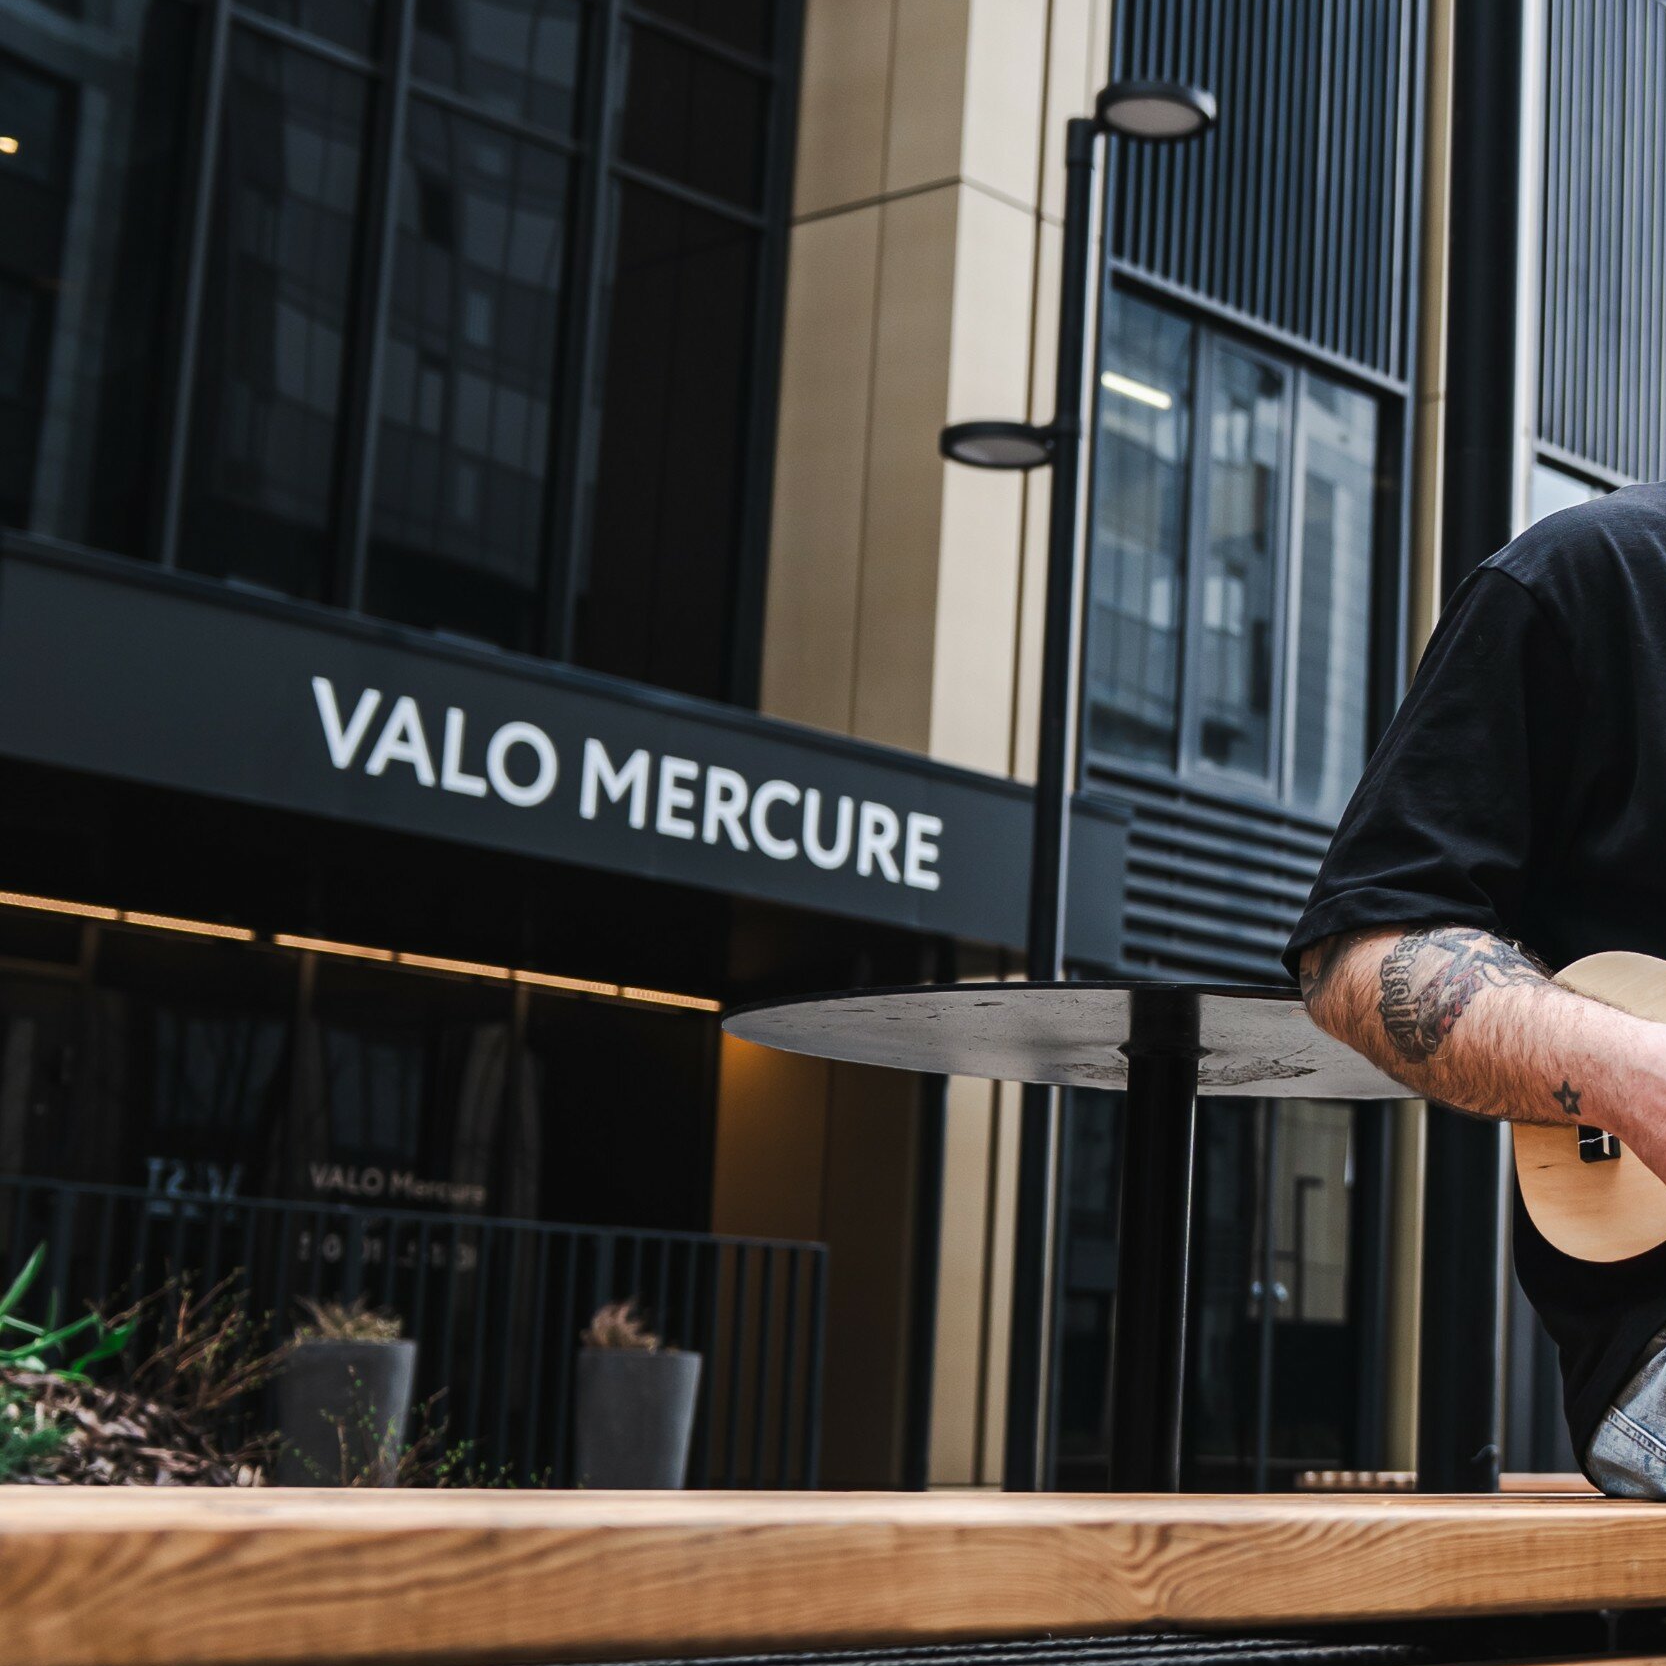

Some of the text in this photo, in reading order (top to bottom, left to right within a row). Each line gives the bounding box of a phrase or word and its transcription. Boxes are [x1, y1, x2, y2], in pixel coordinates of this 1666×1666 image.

[311, 676, 944, 891] VALO MERCURE
[310, 1161, 385, 1197] VALO
